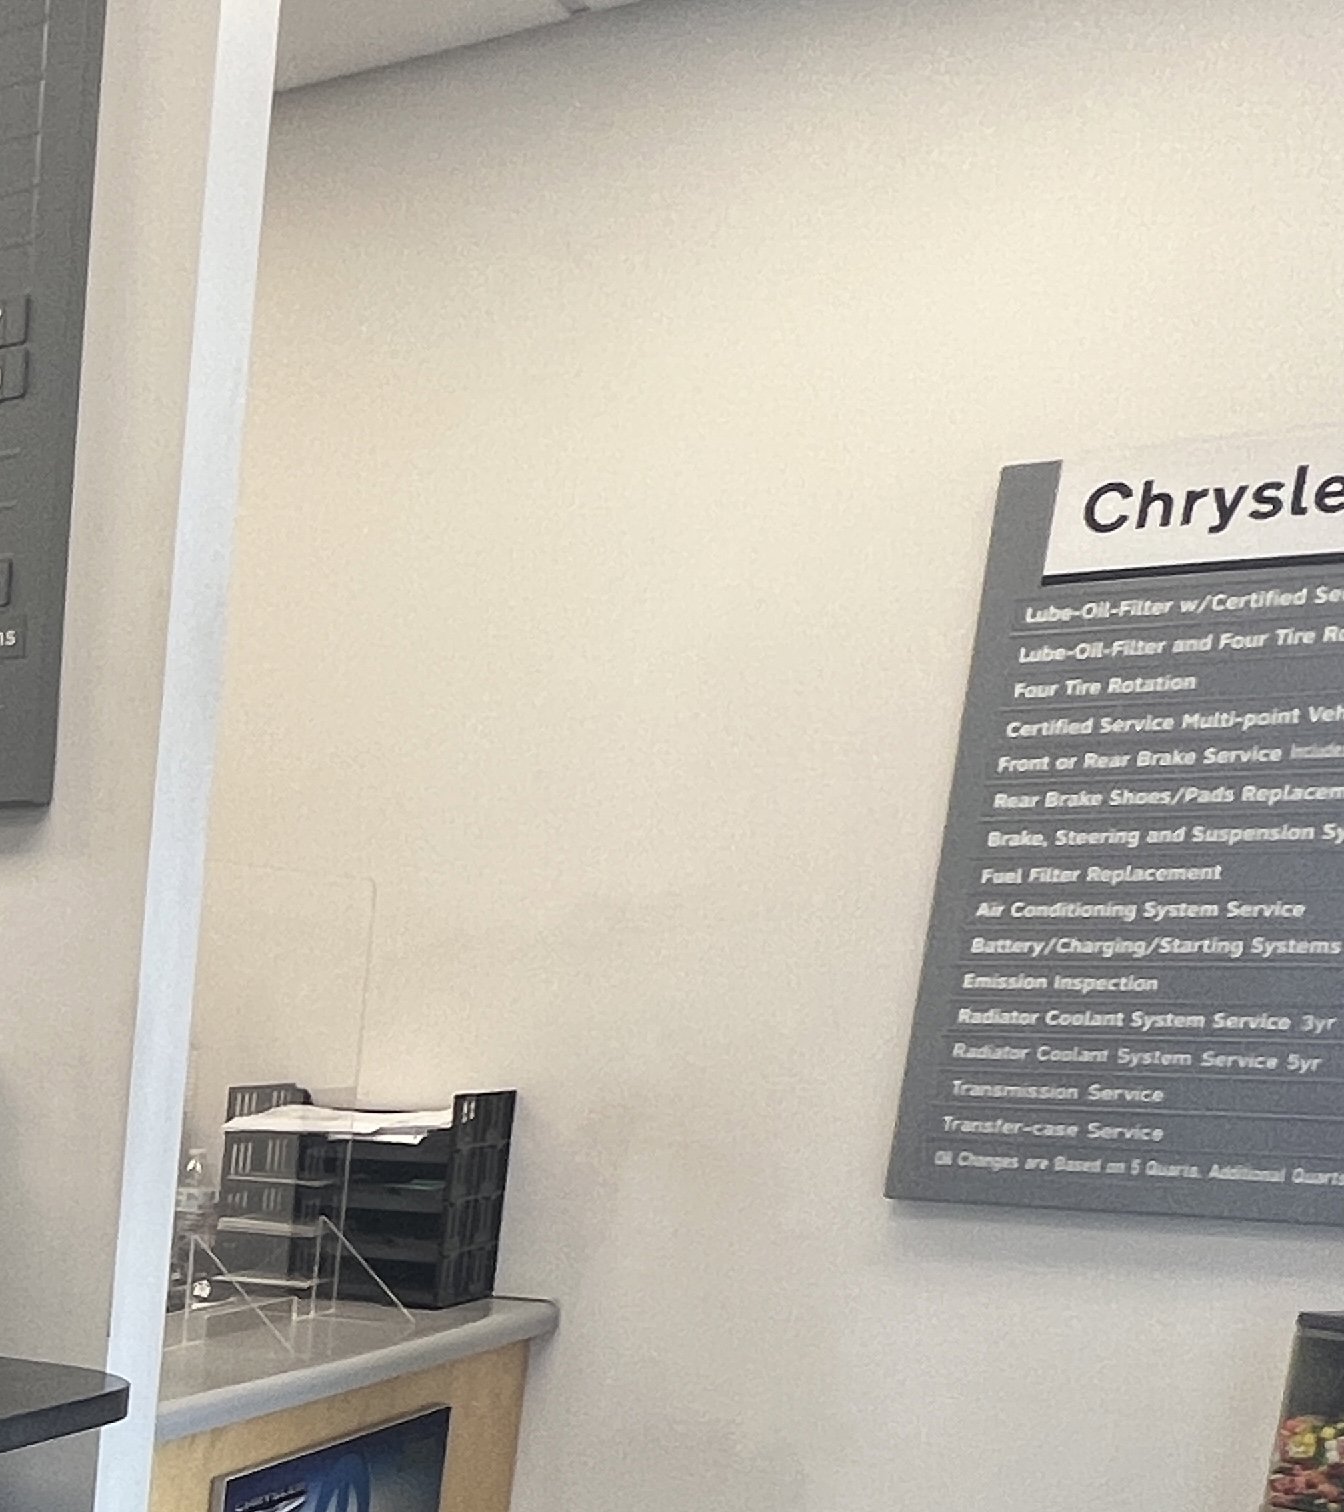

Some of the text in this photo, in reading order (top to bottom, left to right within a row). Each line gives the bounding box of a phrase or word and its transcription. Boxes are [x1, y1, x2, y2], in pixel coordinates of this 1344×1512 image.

[1084, 464, 1344, 534] Chrysle
[1025, 598, 1173, 623] Lube-Oil-Filter
[1181, 587, 1308, 615] w/Certified
[1019, 640, 1166, 664] Lube-Oil-Filter
[1172, 634, 1213, 654] and
[1219, 631, 1269, 651] Four
[1276, 627, 1316, 646] Tire
[1014, 674, 1198, 698] Four Tire Rotation
[1006, 716, 1094, 738] Certified
[1100, 713, 1174, 734] Service
[1182, 708, 1302, 732] Multi-point
[997, 745, 1283, 773] Front or Rear Brake Service
[993, 786, 1235, 808] Rear Brake Shoes/Pads
[1054, 828, 1140, 849] Steering
[1146, 826, 1187, 843] and
[1192, 823, 1315, 846] Suspension
[980, 864, 1222, 886] Fuel Filter Replacement
[1010, 900, 1307, 923] Conditioning System Service
[971, 936, 1342, 958] Battery/Charging/Starting Systems
[962, 973, 1158, 994] Emission Inspection
[957, 1008, 1336, 1034] Radiator Coolant System Service 3yr
[1200, 1050, 1278, 1069] Service
[952, 1080, 1079, 1100] Transmission
